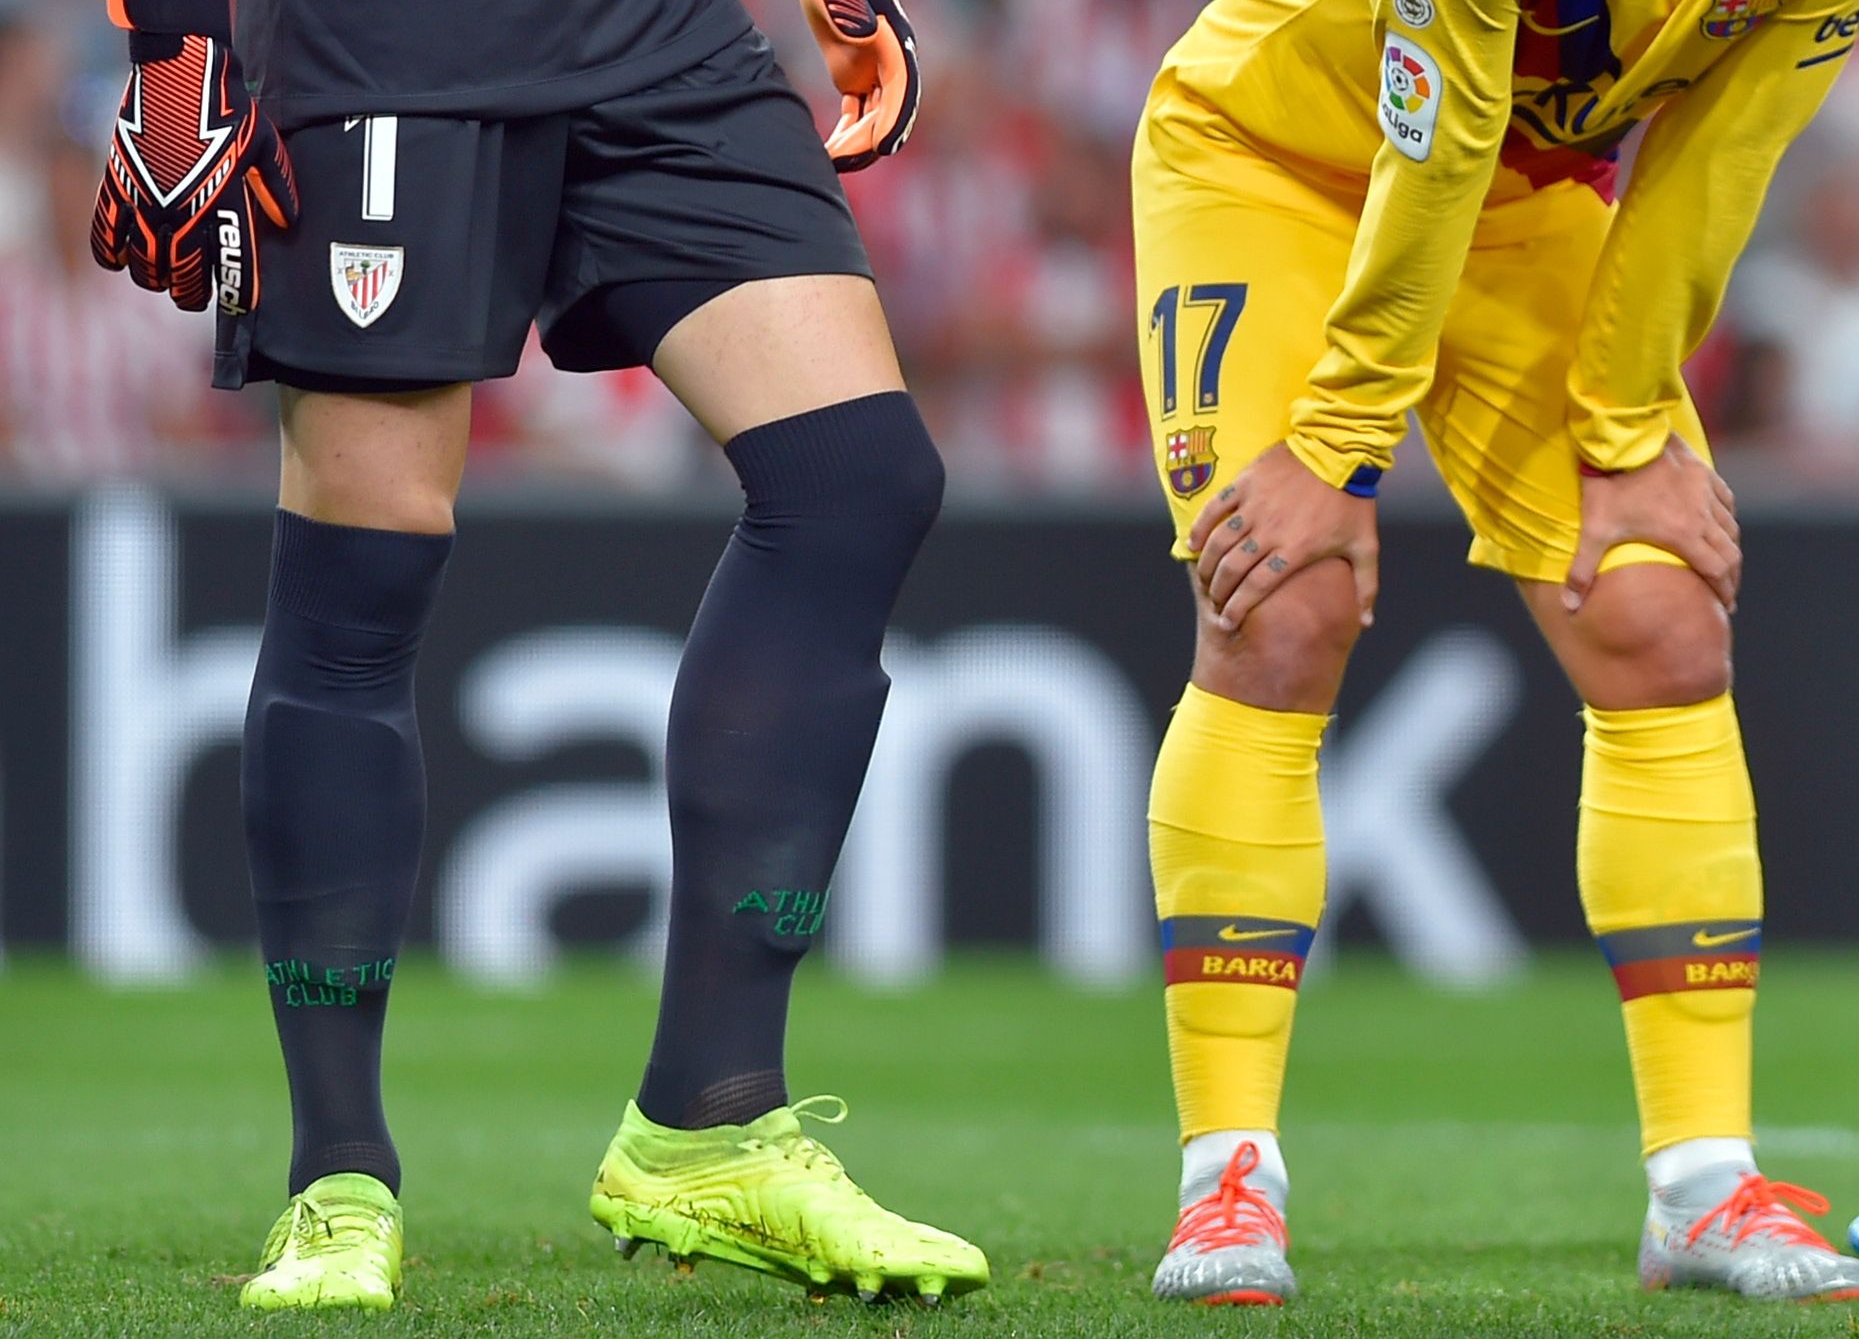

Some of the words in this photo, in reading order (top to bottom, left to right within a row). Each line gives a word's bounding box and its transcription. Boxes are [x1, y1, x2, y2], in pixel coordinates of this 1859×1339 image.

[343, 114, 399, 221] 1
[216, 209, 247, 317] reusch
[1148, 282, 1249, 422] 17
[266, 958, 395, 987] ATHLETIC
[286, 983, 358, 1007] CLUB
[1202, 955, 1296, 981] BARÇA
